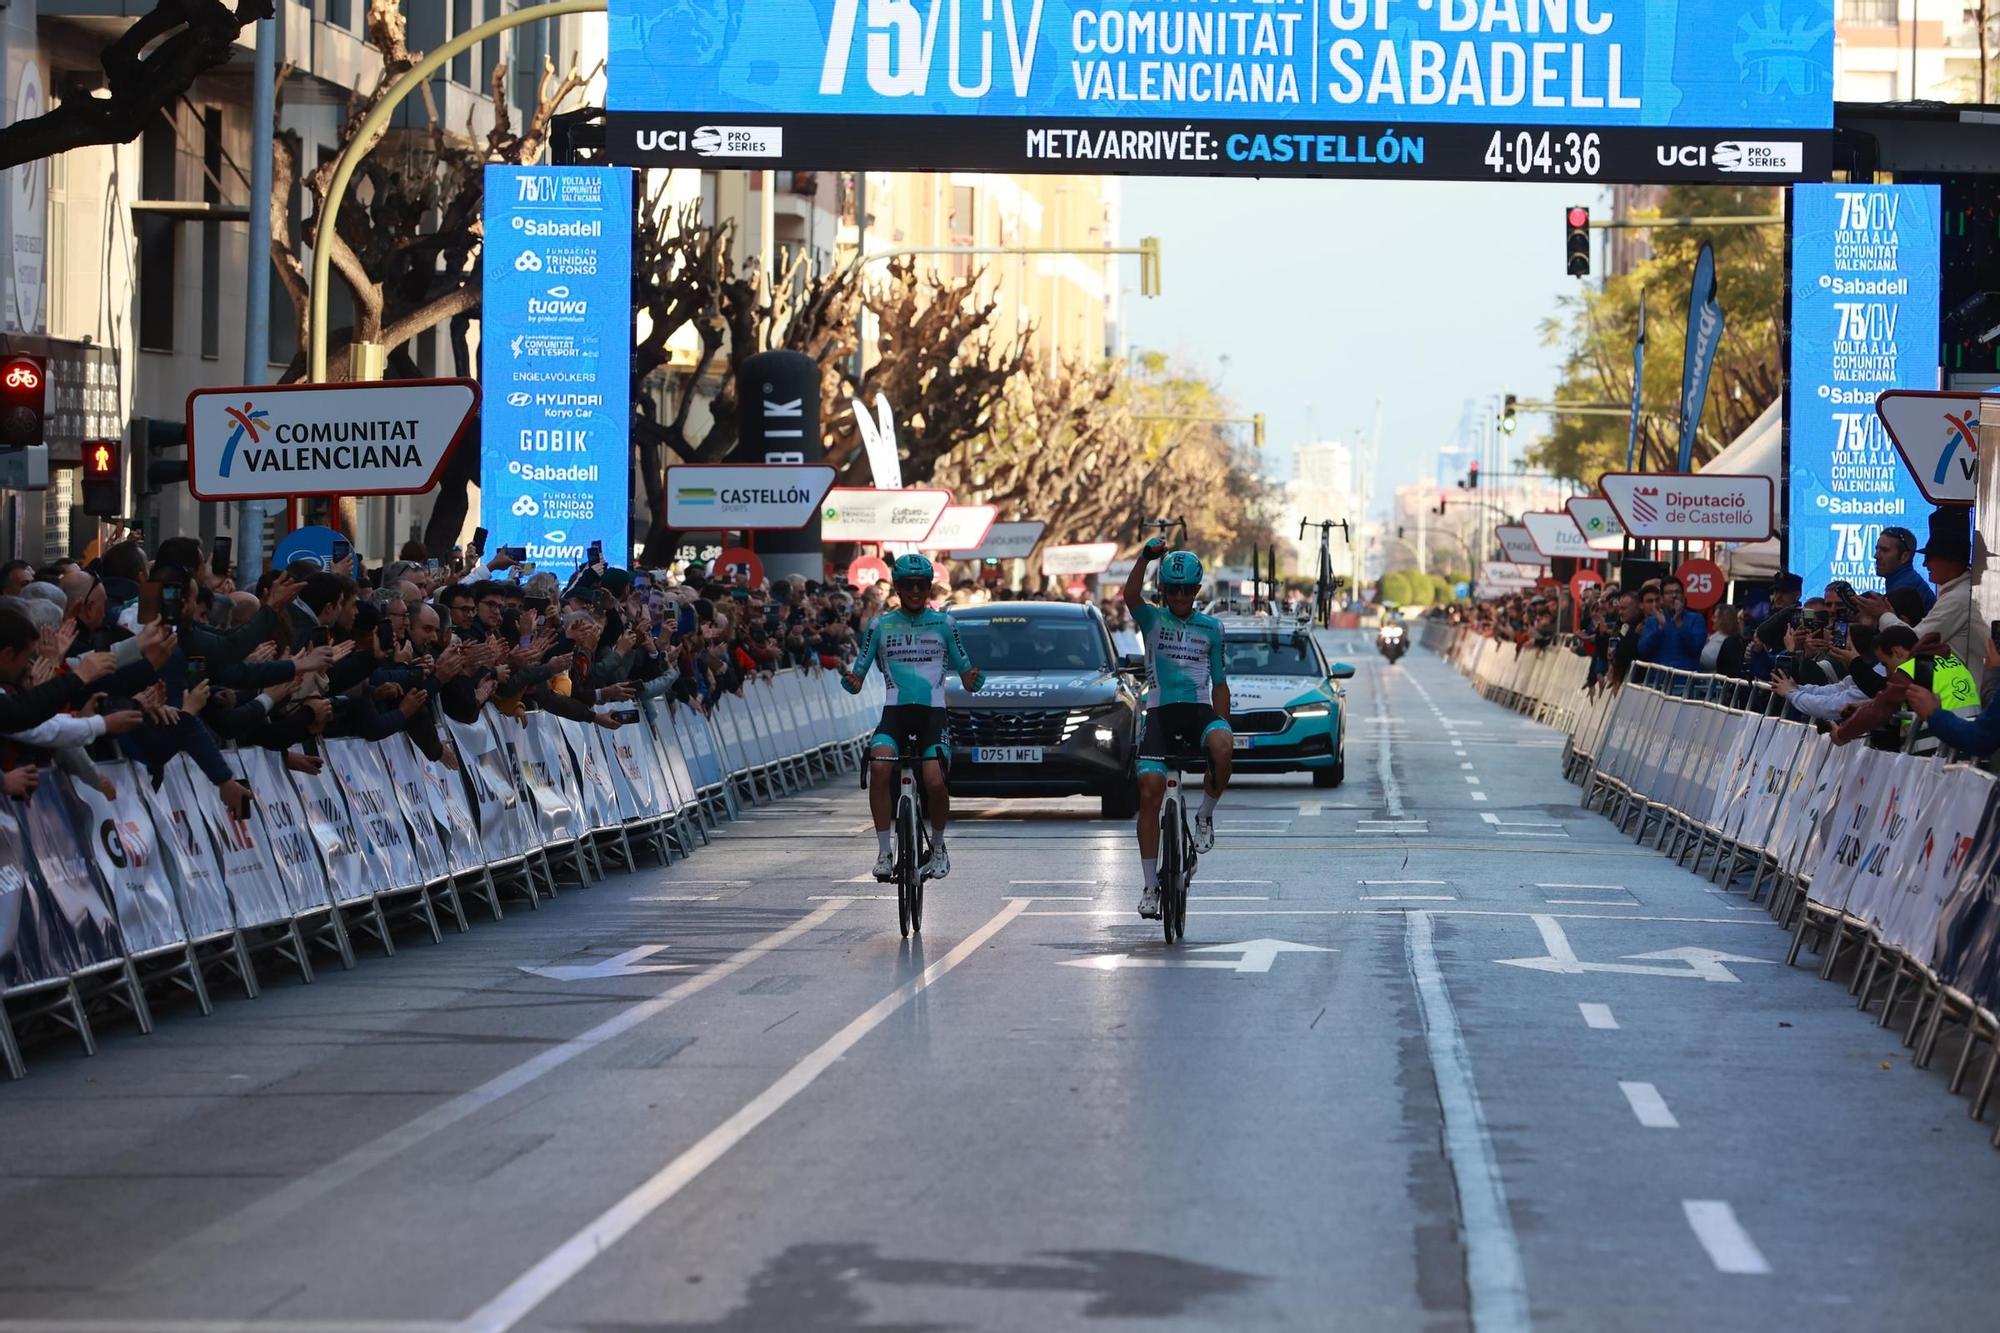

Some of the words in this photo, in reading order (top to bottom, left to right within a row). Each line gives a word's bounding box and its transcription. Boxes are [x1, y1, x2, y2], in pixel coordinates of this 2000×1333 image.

[1072, 10, 1302, 56] COMUNITAT
[1329, 39, 1641, 108] SABADELL
[1071, 60, 1300, 102] VALENCIANA
[636, 130, 687, 151] UCI
[728, 132, 751, 141] PRO
[728, 142, 766, 151] SERIES
[1026, 125, 1219, 161] META/ARRIVÉE:
[1226, 129, 1425, 164] CASTELLÓN
[1484, 130, 1601, 175] 4:04:36
[1657, 145, 1706, 166] UCI
[1748, 148, 1771, 156] PRO
[1748, 157, 1786, 166] SERIES
[524, 219, 601, 237] Sabadell
[1834, 231, 1869, 244] VOLTA
[1872, 231, 1880, 244] A
[1884, 231, 1899, 245] LA
[1834, 245, 1898, 259] COMUNITAT
[545, 255, 597, 265] TRINIDAD
[1834, 259, 1898, 271] VALENCIANA
[546, 265, 597, 275] ALFONSO
[1832, 278, 1908, 294] Sabadell
[528, 298, 587, 314] tuawa
[525, 340, 574, 348] COMUNITAT
[1833, 341, 1868, 355] VOLTA
[1871, 341, 1880, 355] A
[1883, 341, 1898, 355] LA
[1833, 356, 1897, 369] COMUNITAT
[1833, 369, 1896, 382] VALENCIANA
[536, 393, 602, 406] HYUNDAI
[545, 408, 573, 418] Koryo
[575, 408, 593, 418] Car
[275, 420, 419, 444] COMUNITAT
[520, 429, 587, 452] GOBIK
[243, 444, 423, 472] VALENCIANA
[1831, 452, 1867, 465] VOLTA
[1869, 452, 1878, 465] A
[1881, 452, 1896, 465] LA
[521, 465, 598, 481] Sabadell
[1831, 466, 1895, 480] COMUNITAT
[1831, 480, 1895, 493] VALENCIANA
[721, 485, 809, 504] CASTELLÓN
[1666, 492, 1745, 509] Diputació
[543, 500, 594, 510] TRINIDAD
[1829, 498, 1905, 515] Sabadell
[543, 510, 594, 519] ALFONSO
[1666, 509, 1686, 522] de
[1689, 509, 1753, 524] Castelló
[526, 542, 584, 558] tuawa
[1831, 562, 1865, 575] VOLTA
[1686, 573, 1712, 593] 25
[972, 690, 1015, 698] Koryo
[981, 749, 1011, 761] 0751
[1016, 749, 1039, 761] MFL
